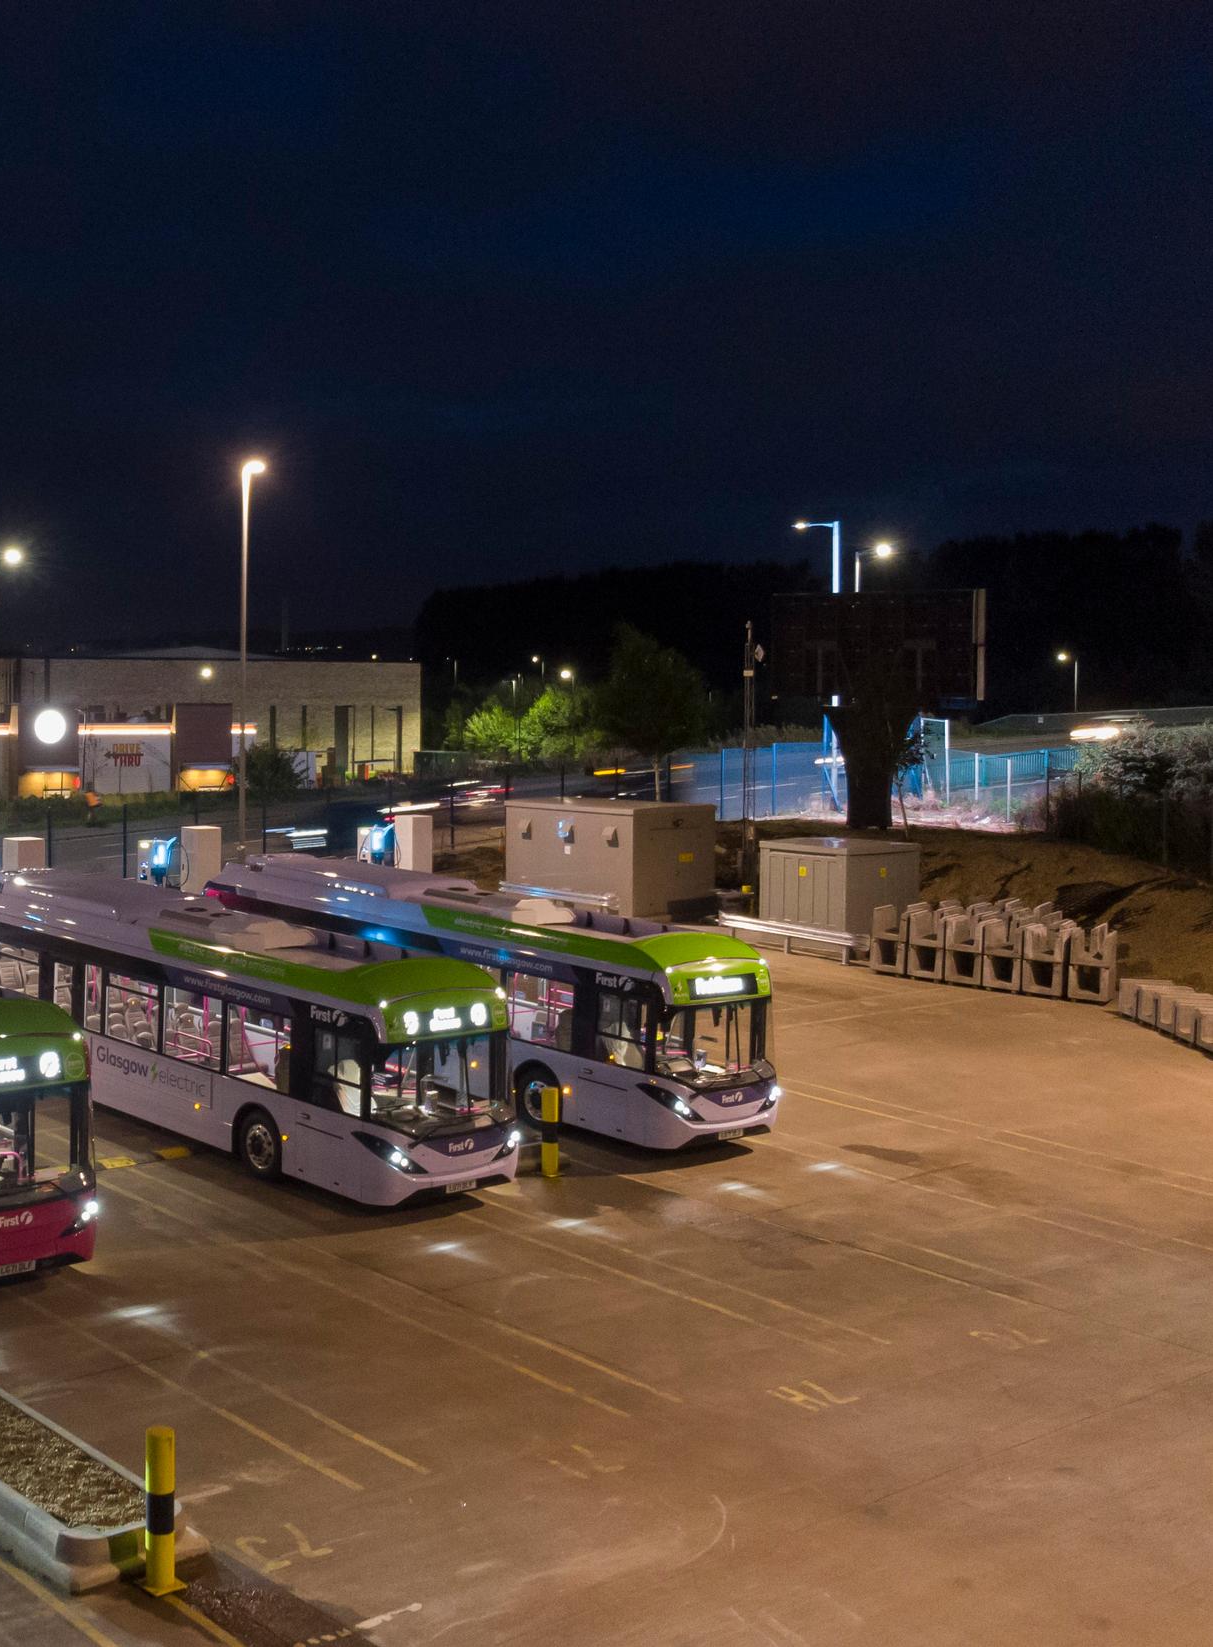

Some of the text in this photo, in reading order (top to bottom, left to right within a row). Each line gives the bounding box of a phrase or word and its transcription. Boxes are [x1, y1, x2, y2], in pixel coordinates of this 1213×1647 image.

[113, 743, 142, 754] DRIVE
[114, 754, 141, 767] THRU
[595, 972, 618, 989] First
[309, 1005, 332, 1023] First
[96, 1045, 207, 1098] Glasgow electric
[721, 1094, 736, 1104] First
[448, 1141, 465, 1153] First
